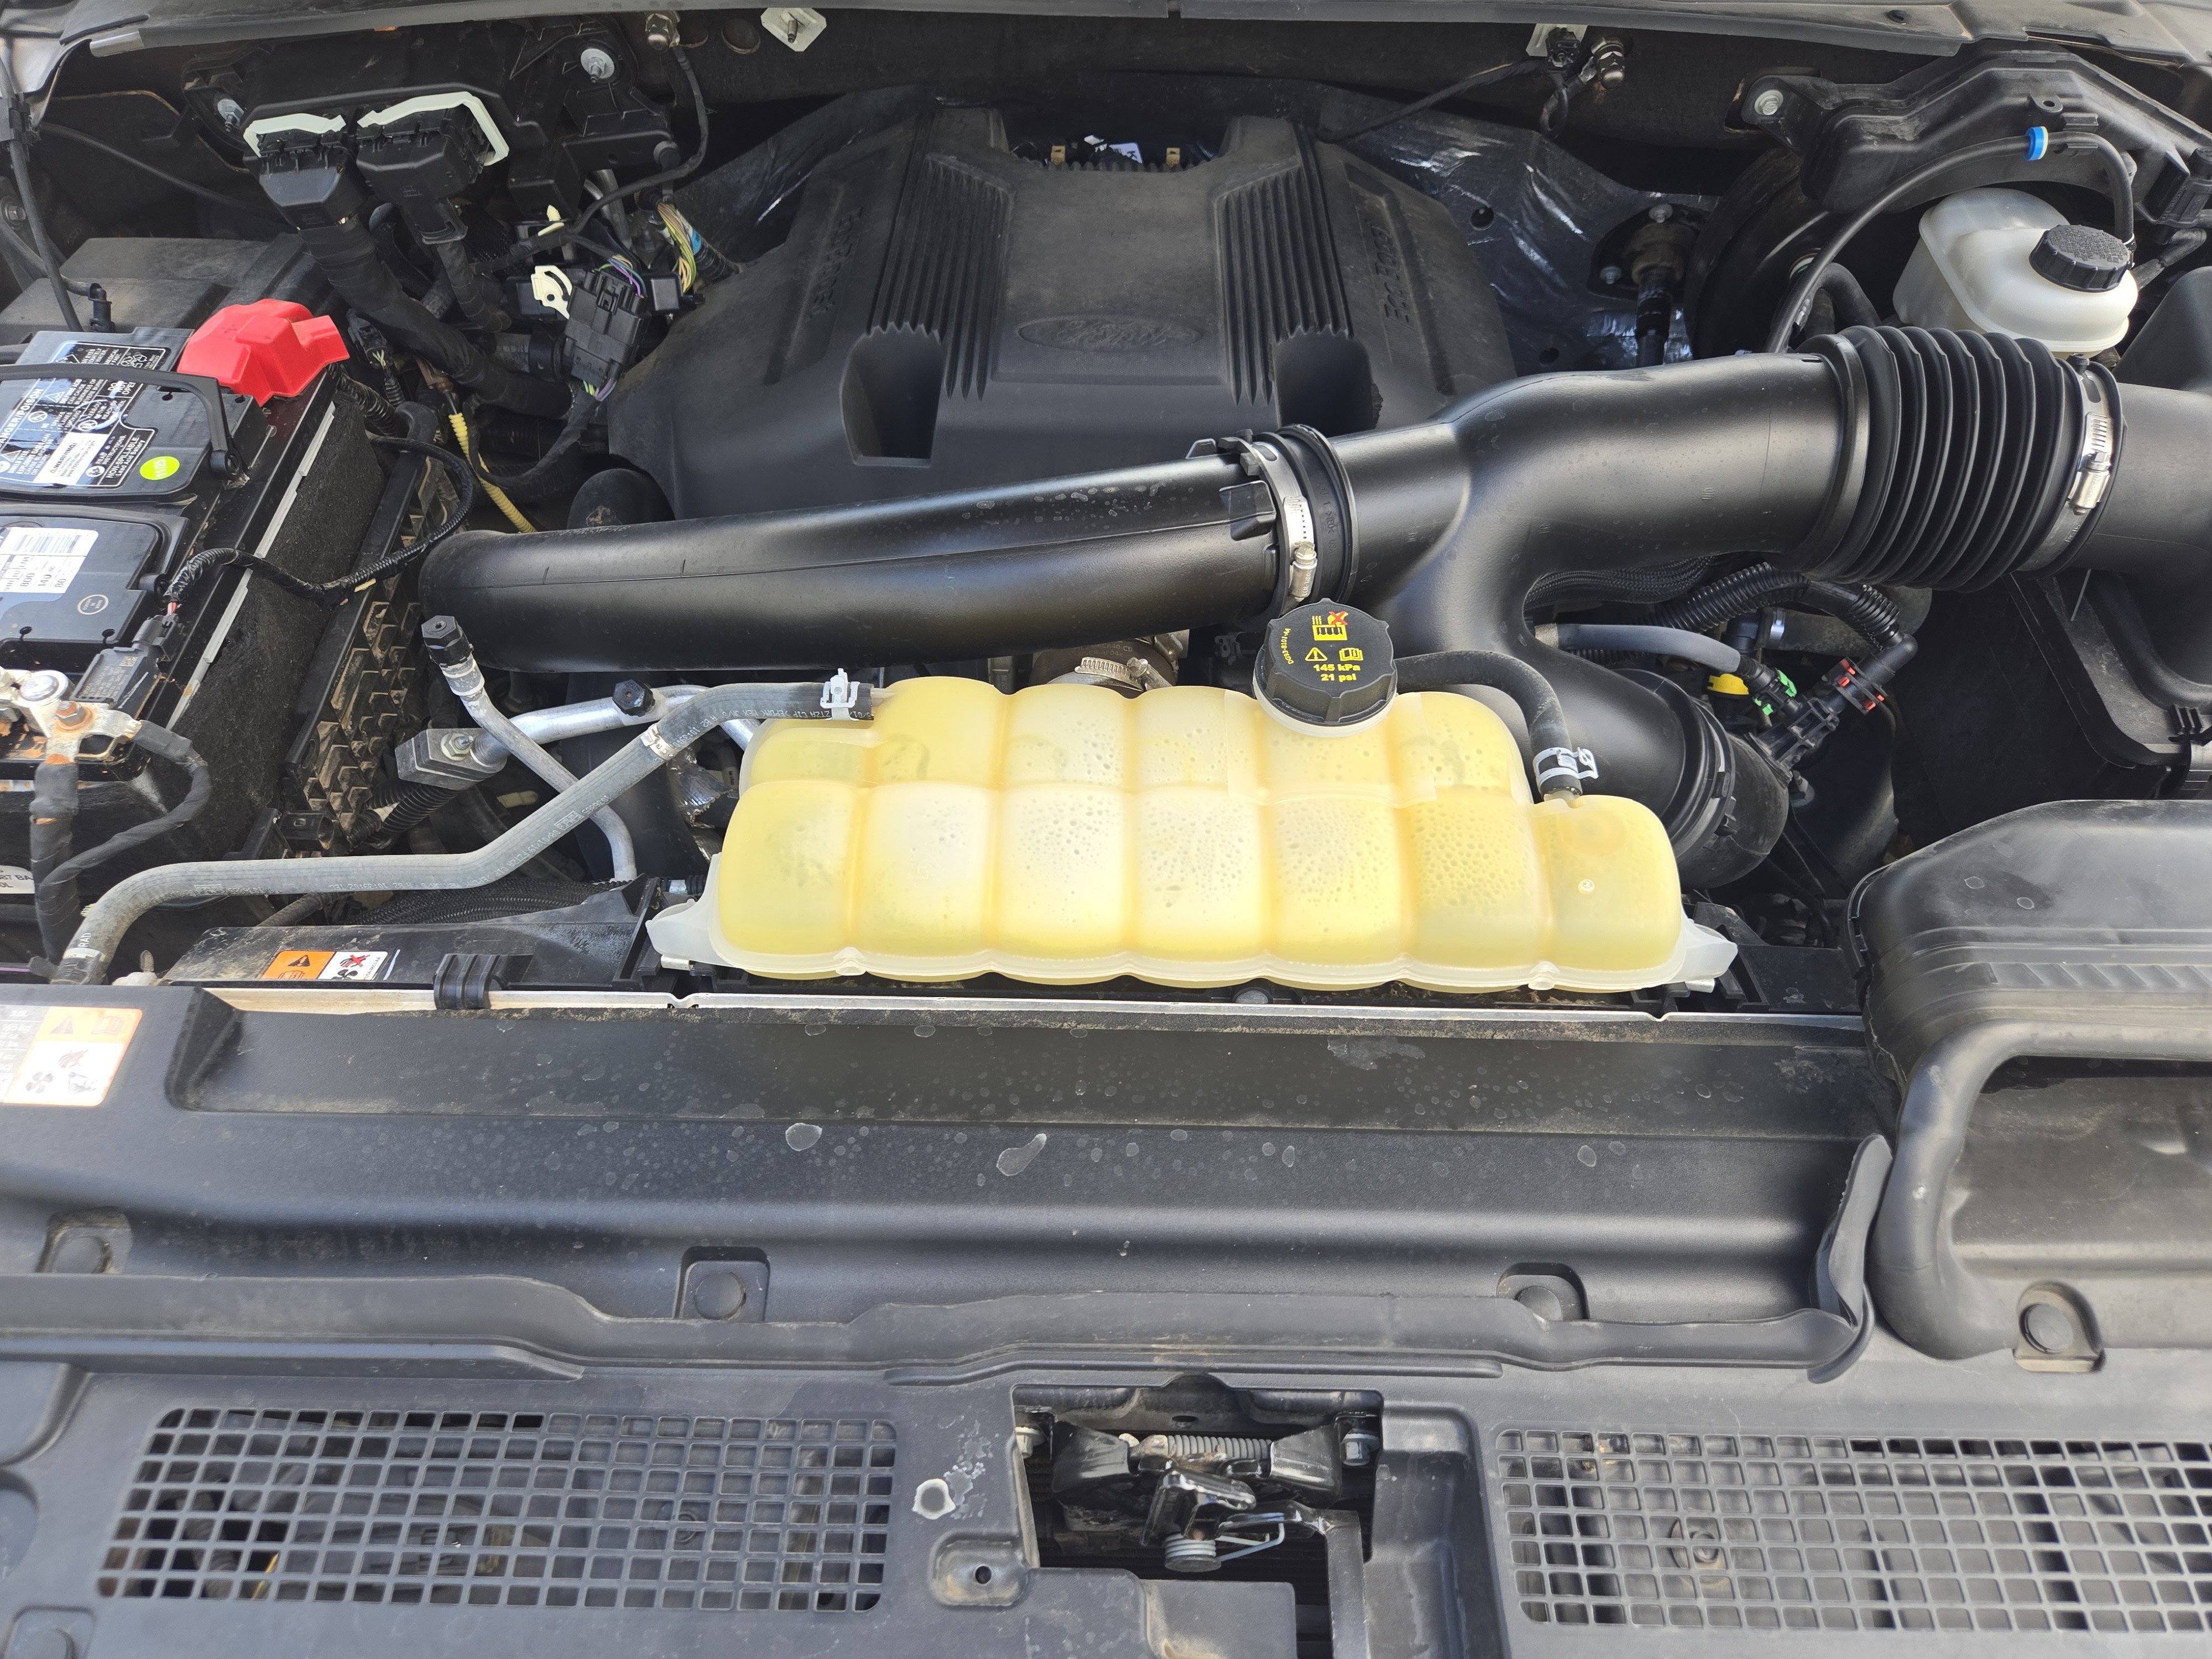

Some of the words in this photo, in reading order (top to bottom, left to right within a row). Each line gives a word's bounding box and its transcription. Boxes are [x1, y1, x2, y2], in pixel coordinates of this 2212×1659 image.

[73, 383, 86, 395] CAUSE
[74, 384, 93, 404] BLINDNESS
[0, 388, 44, 445] ANGER/POISON
[53, 442, 78, 468] WARNING!
[101, 434, 128, 464] INSTRUCTIONS.
[105, 437, 140, 478] NON-SPILLABLE
[115, 465, 128, 476] Lead
[123, 455, 134, 464] Acid
[130, 440, 147, 455] Battery
[19, 573, 36, 587] 800
[36, 574, 53, 587] 140
[54, 578, 67, 587] 80
[1313, 664, 1335, 672] 145
[1339, 673, 1356, 682] psi
[792, 710, 807, 718] CIP
[672, 727, 700, 747] 10:39:0
[77, 932, 91, 947] RAD
